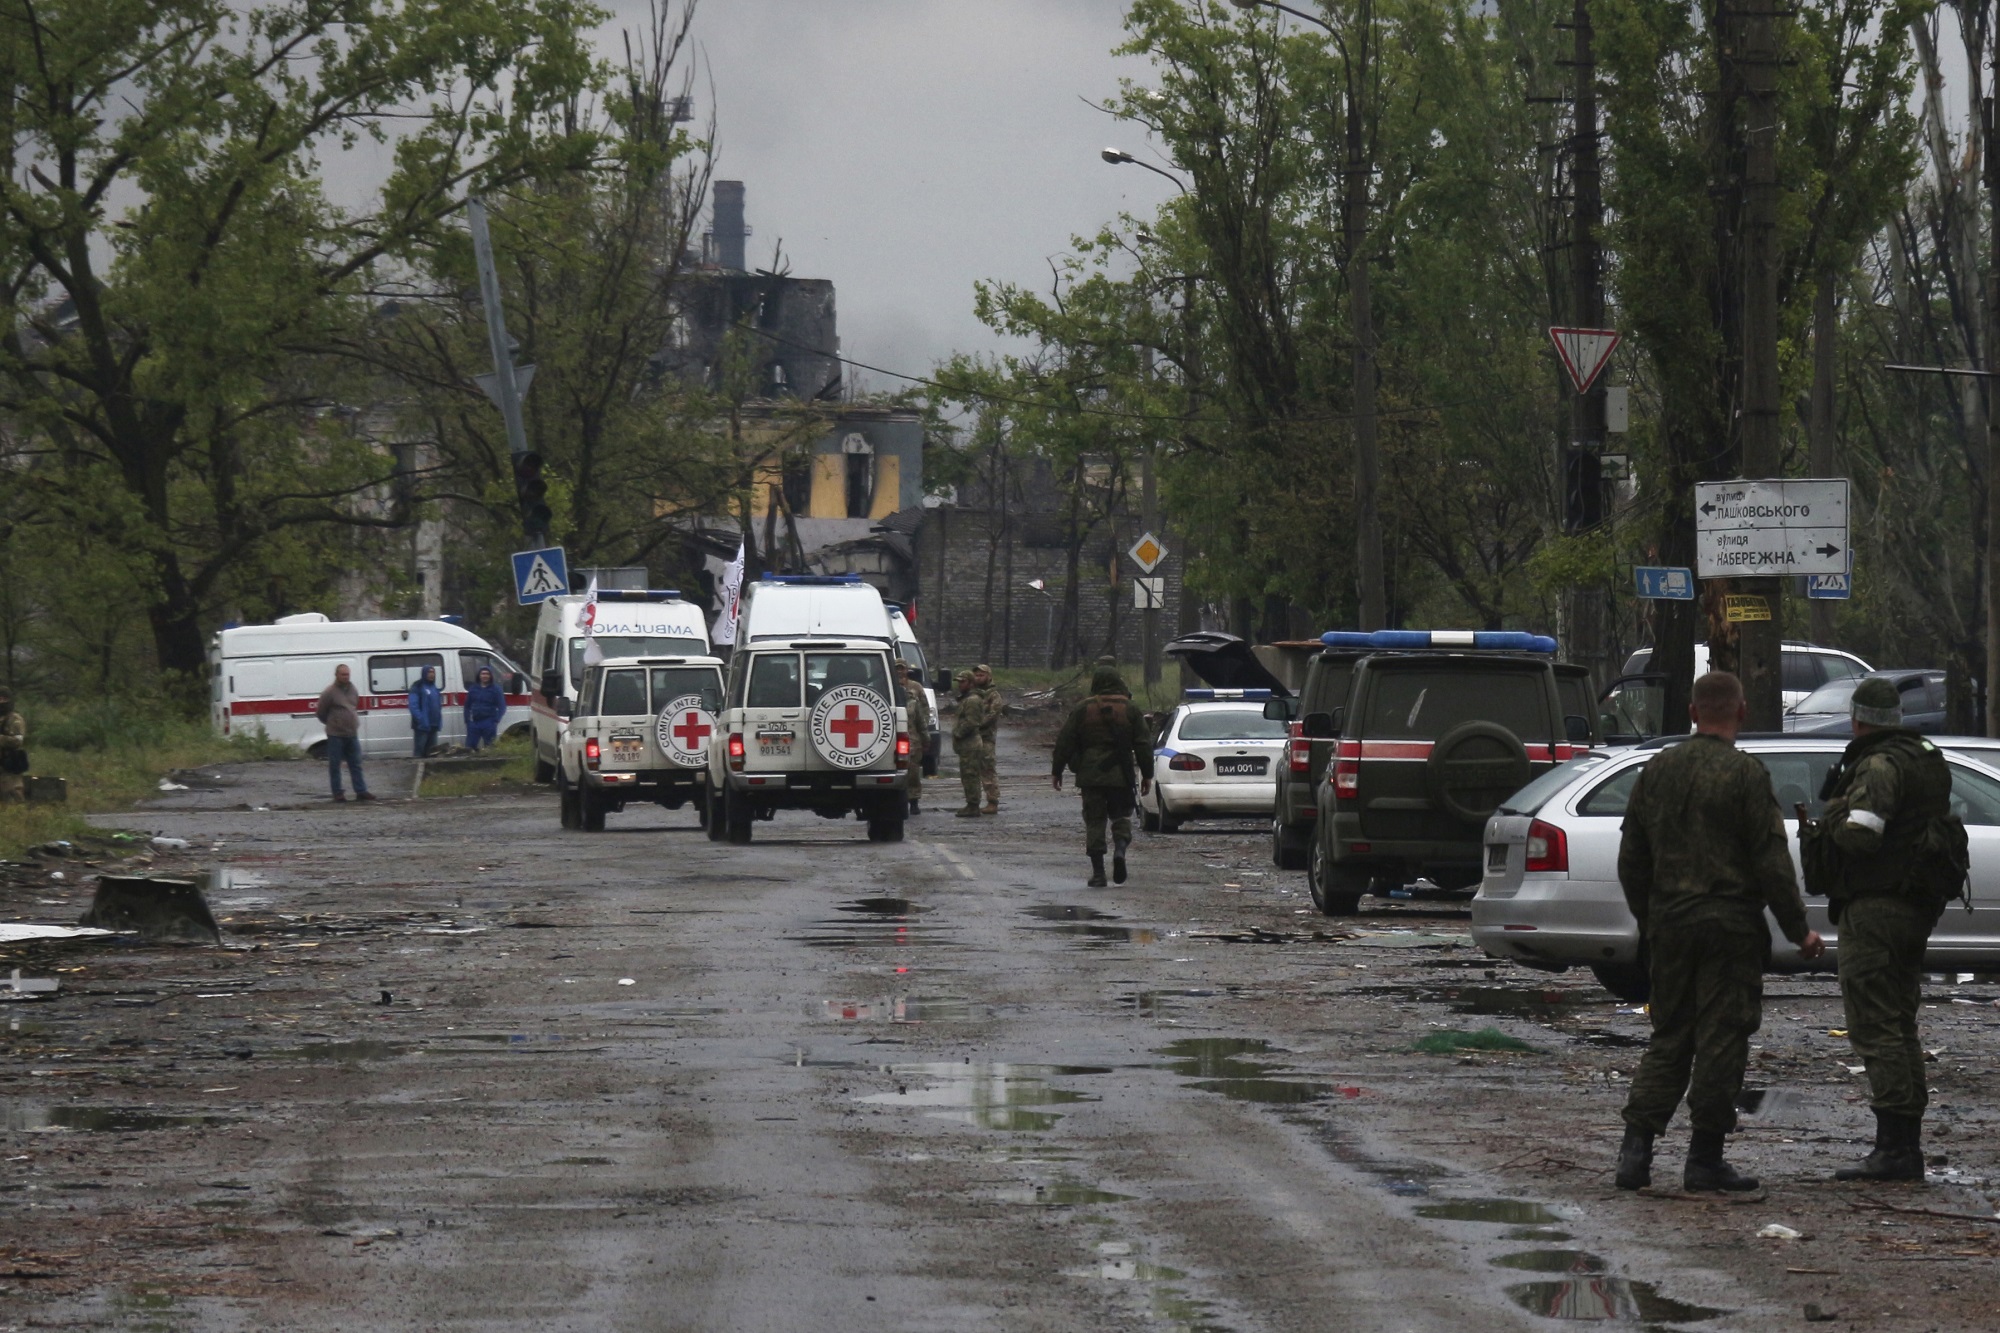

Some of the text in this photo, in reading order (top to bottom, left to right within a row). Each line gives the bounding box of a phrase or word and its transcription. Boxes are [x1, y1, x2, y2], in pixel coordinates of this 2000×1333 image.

[1717, 505, 1810, 519] ПАШКОВСЬКОГО
[1717, 534, 1748, 549] вулиця
[1716, 551, 1795, 566] НАБЕРЕЖНА
[813, 688, 891, 746] COMITE INTERNATIONAL
[659, 709, 674, 748] COMITE
[828, 749, 877, 766] GENEVE
[1237, 763, 1253, 773] 001
